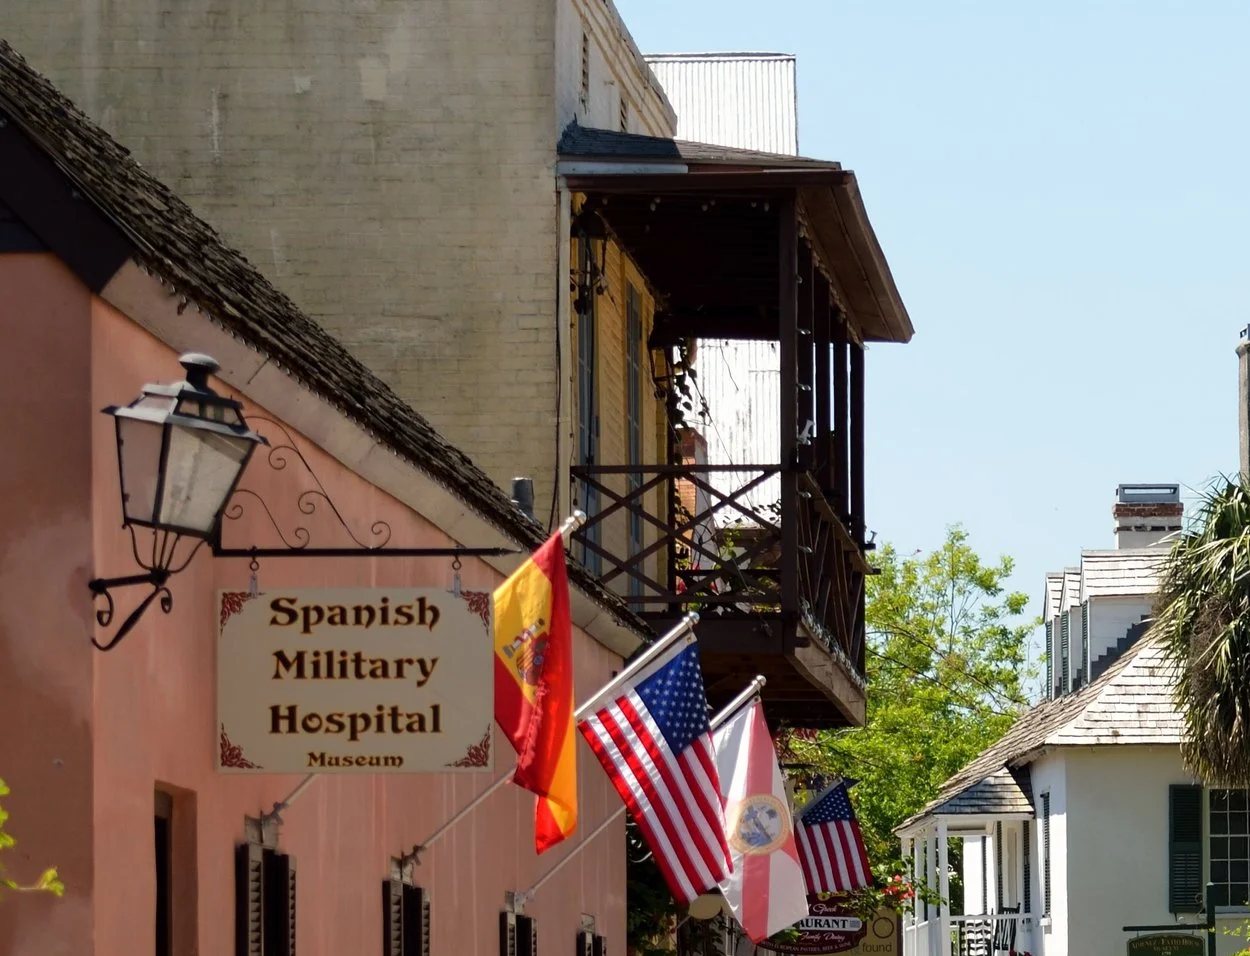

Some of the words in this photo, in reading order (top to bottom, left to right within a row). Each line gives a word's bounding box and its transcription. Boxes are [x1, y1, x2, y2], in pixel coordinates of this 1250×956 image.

[269, 596, 441, 634] Spanish
[272, 649, 439, 687] Military
[268, 703, 442, 741] Hospital
[307, 751, 404, 767] Museum
[862, 942, 893, 952] found
